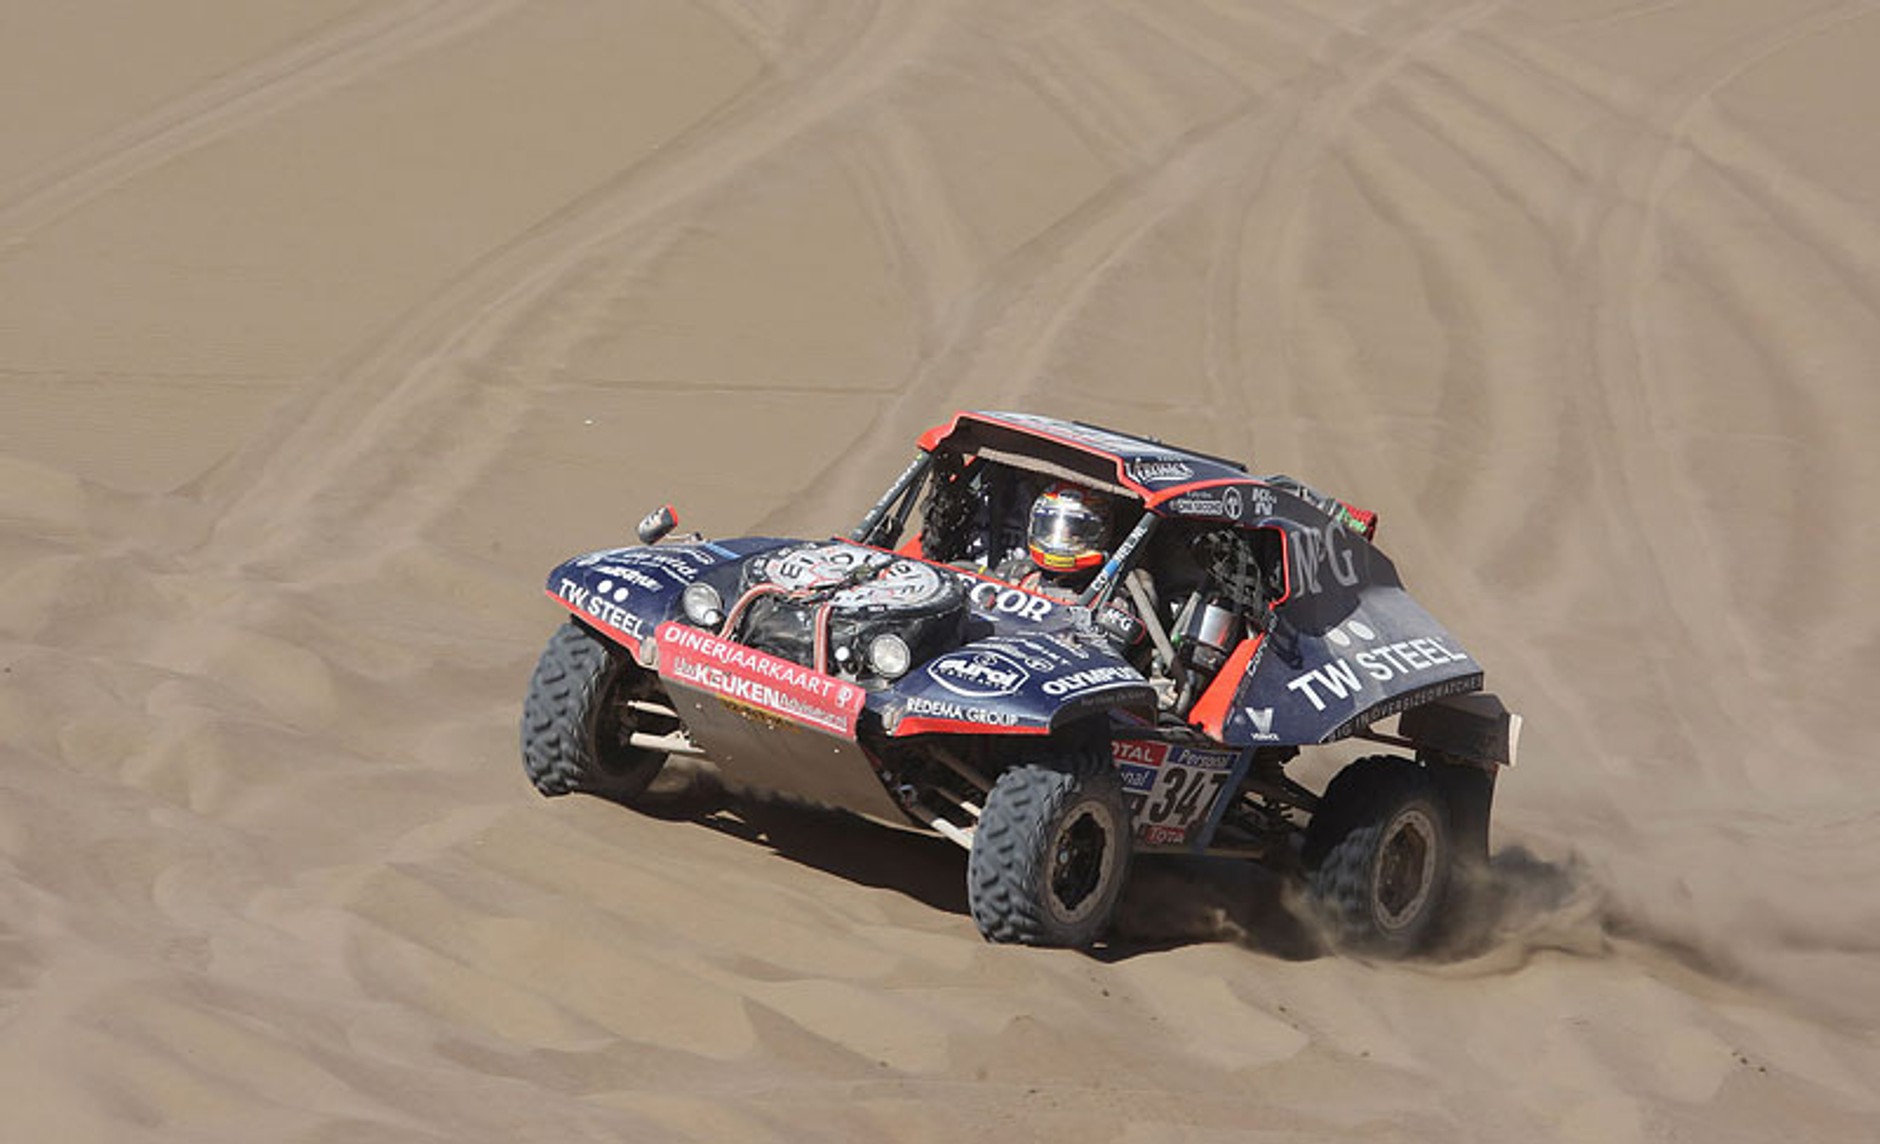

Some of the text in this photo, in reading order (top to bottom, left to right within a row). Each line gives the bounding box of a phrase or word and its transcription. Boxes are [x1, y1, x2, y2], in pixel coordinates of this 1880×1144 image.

[559, 577, 590, 606] TW
[587, 597, 644, 640] STEEL
[664, 626, 836, 697] DINERJAARKAART
[1287, 636, 1468, 711] TW STEEL
[906, 697, 1019, 727] REDEMA GROUP
[1112, 742, 1153, 763] OTAL
[1150, 766, 1229, 825] 347
